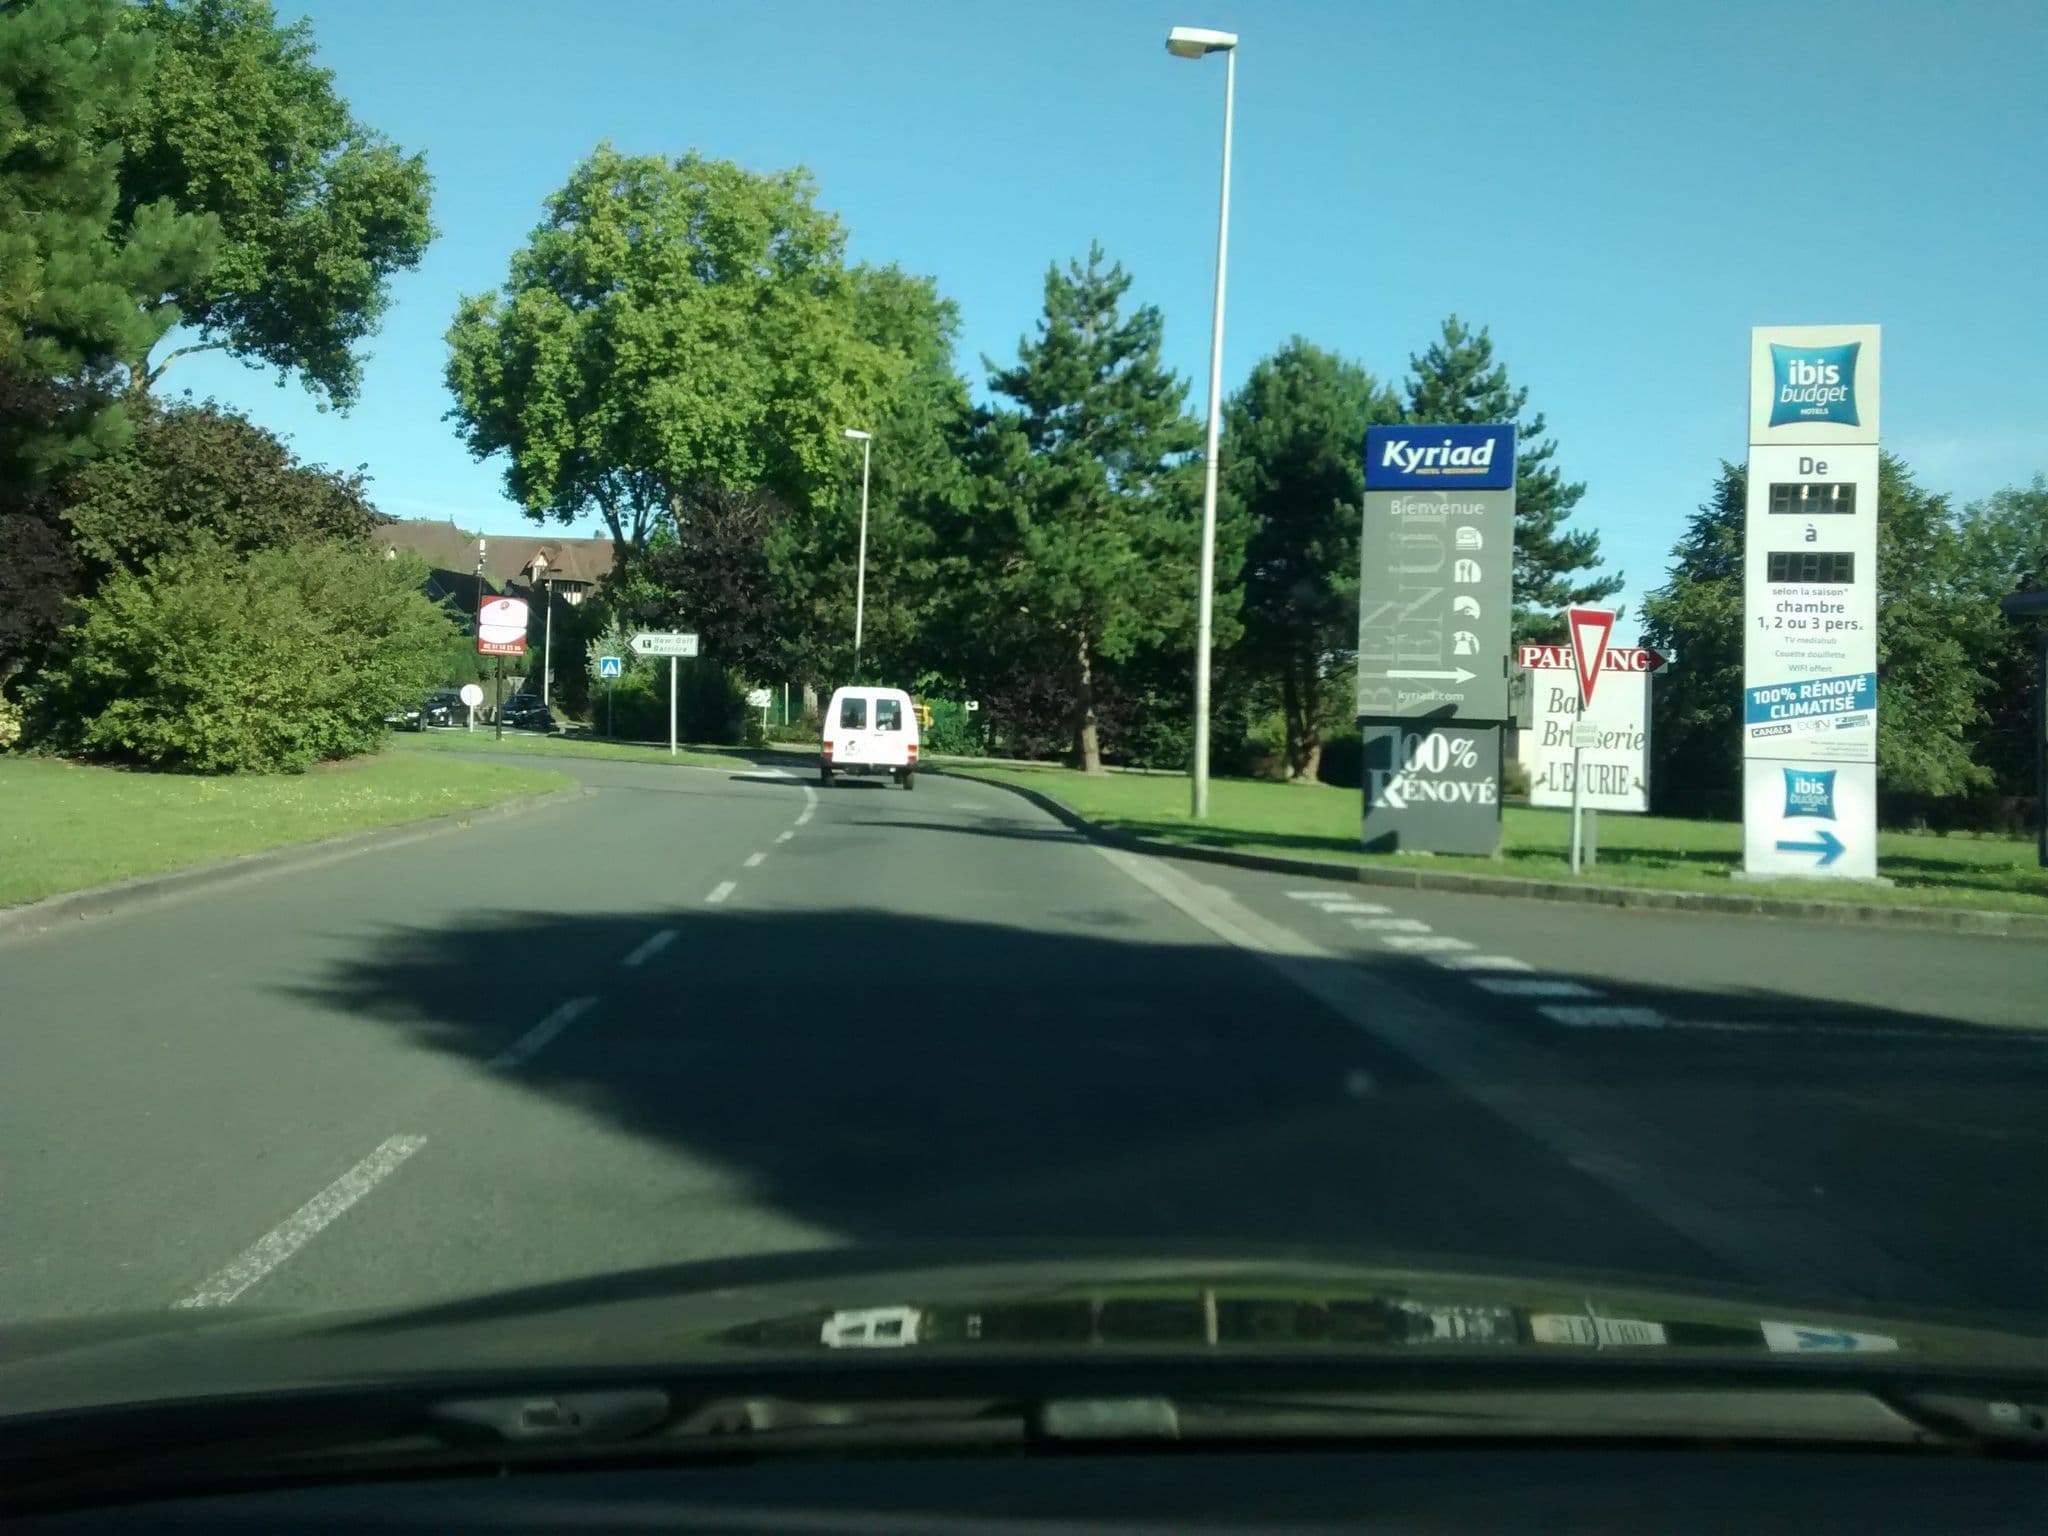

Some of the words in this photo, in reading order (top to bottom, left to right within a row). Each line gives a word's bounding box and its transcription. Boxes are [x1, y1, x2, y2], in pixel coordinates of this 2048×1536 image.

[1789, 359, 1840, 385] ibis
[1780, 384, 1848, 406] budget
[1382, 438, 1496, 474] Kyriad
[1799, 457, 1828, 475] De
[1391, 500, 1485, 515] Bienvenue
[1805, 523, 1817, 542] à
[1772, 588, 1798, 596] selon
[1801, 588, 1810, 596] la
[1776, 600, 1845, 613] chambre
[1758, 616, 1769, 631] 1,
[1774, 616, 1783, 629] 2
[1787, 619, 1807, 629] ou
[1812, 617, 1820, 629] 3
[1521, 647, 1650, 671] PARING
[1547, 687, 1577, 714] Ba
[1753, 688, 1797, 705] 100%
[1800, 676, 1867, 699] RÉNOVÉ
[1770, 694, 1856, 719] CLIMATISÉ
[1752, 725, 1791, 737] CANAL+
[1369, 768, 1497, 809] RÉNOVÉ
[1795, 778, 1825, 794] ibis
